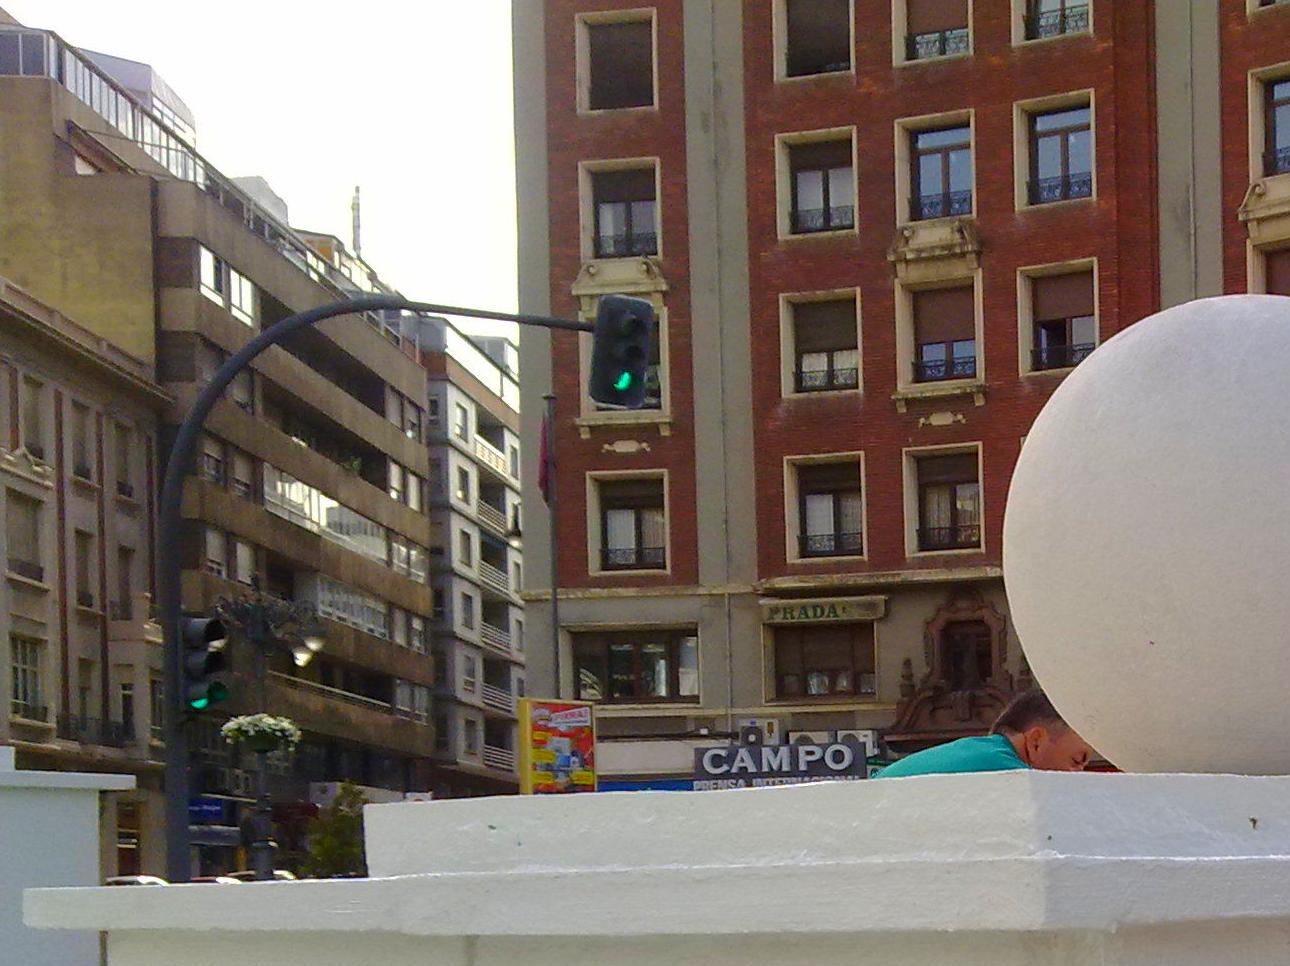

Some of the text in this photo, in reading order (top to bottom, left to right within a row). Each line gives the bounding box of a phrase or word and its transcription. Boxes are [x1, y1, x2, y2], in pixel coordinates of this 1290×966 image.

[768, 603, 840, 620] PRADA
[702, 743, 854, 775] CAMPO
[693, 779, 748, 792] PRENSA
